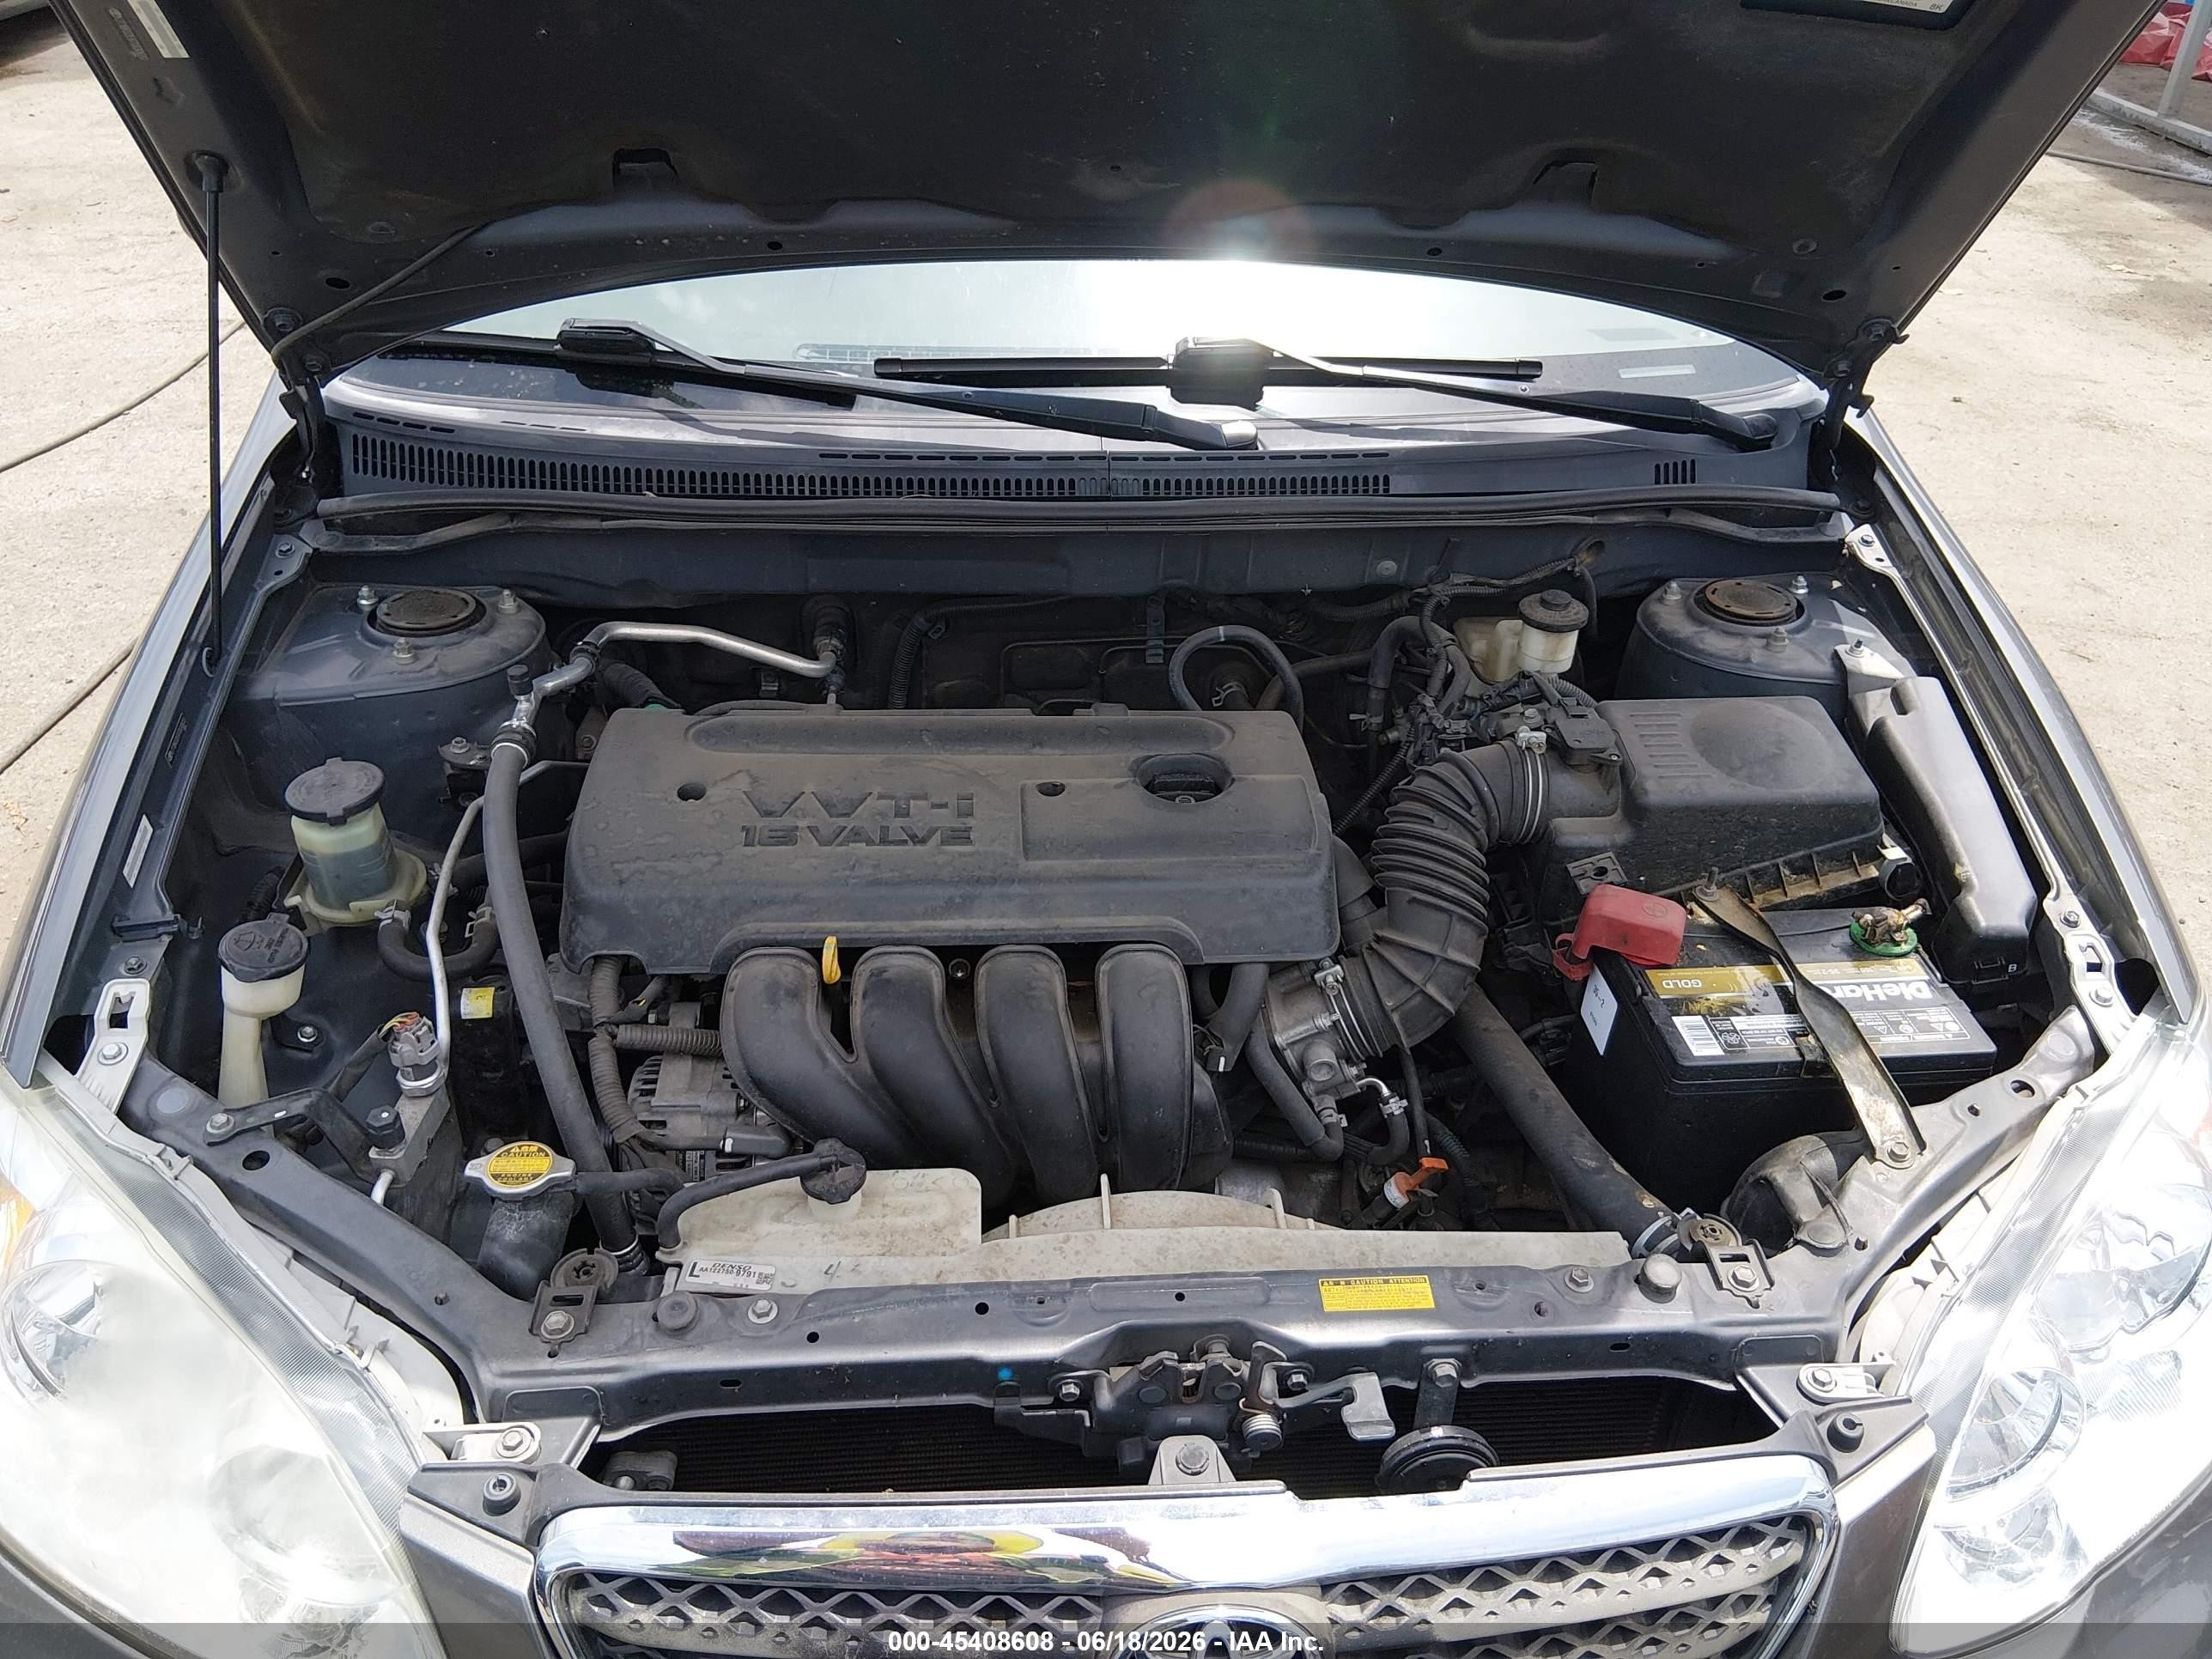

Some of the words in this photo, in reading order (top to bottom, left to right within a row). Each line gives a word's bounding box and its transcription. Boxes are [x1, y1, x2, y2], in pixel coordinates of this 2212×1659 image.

[741, 824, 799, 847] 16
[807, 824, 975, 847] VALVE
[2008, 963, 2018, 973] B
[1662, 979, 1703, 989] GOLD
[688, 1261, 701, 1278] L
